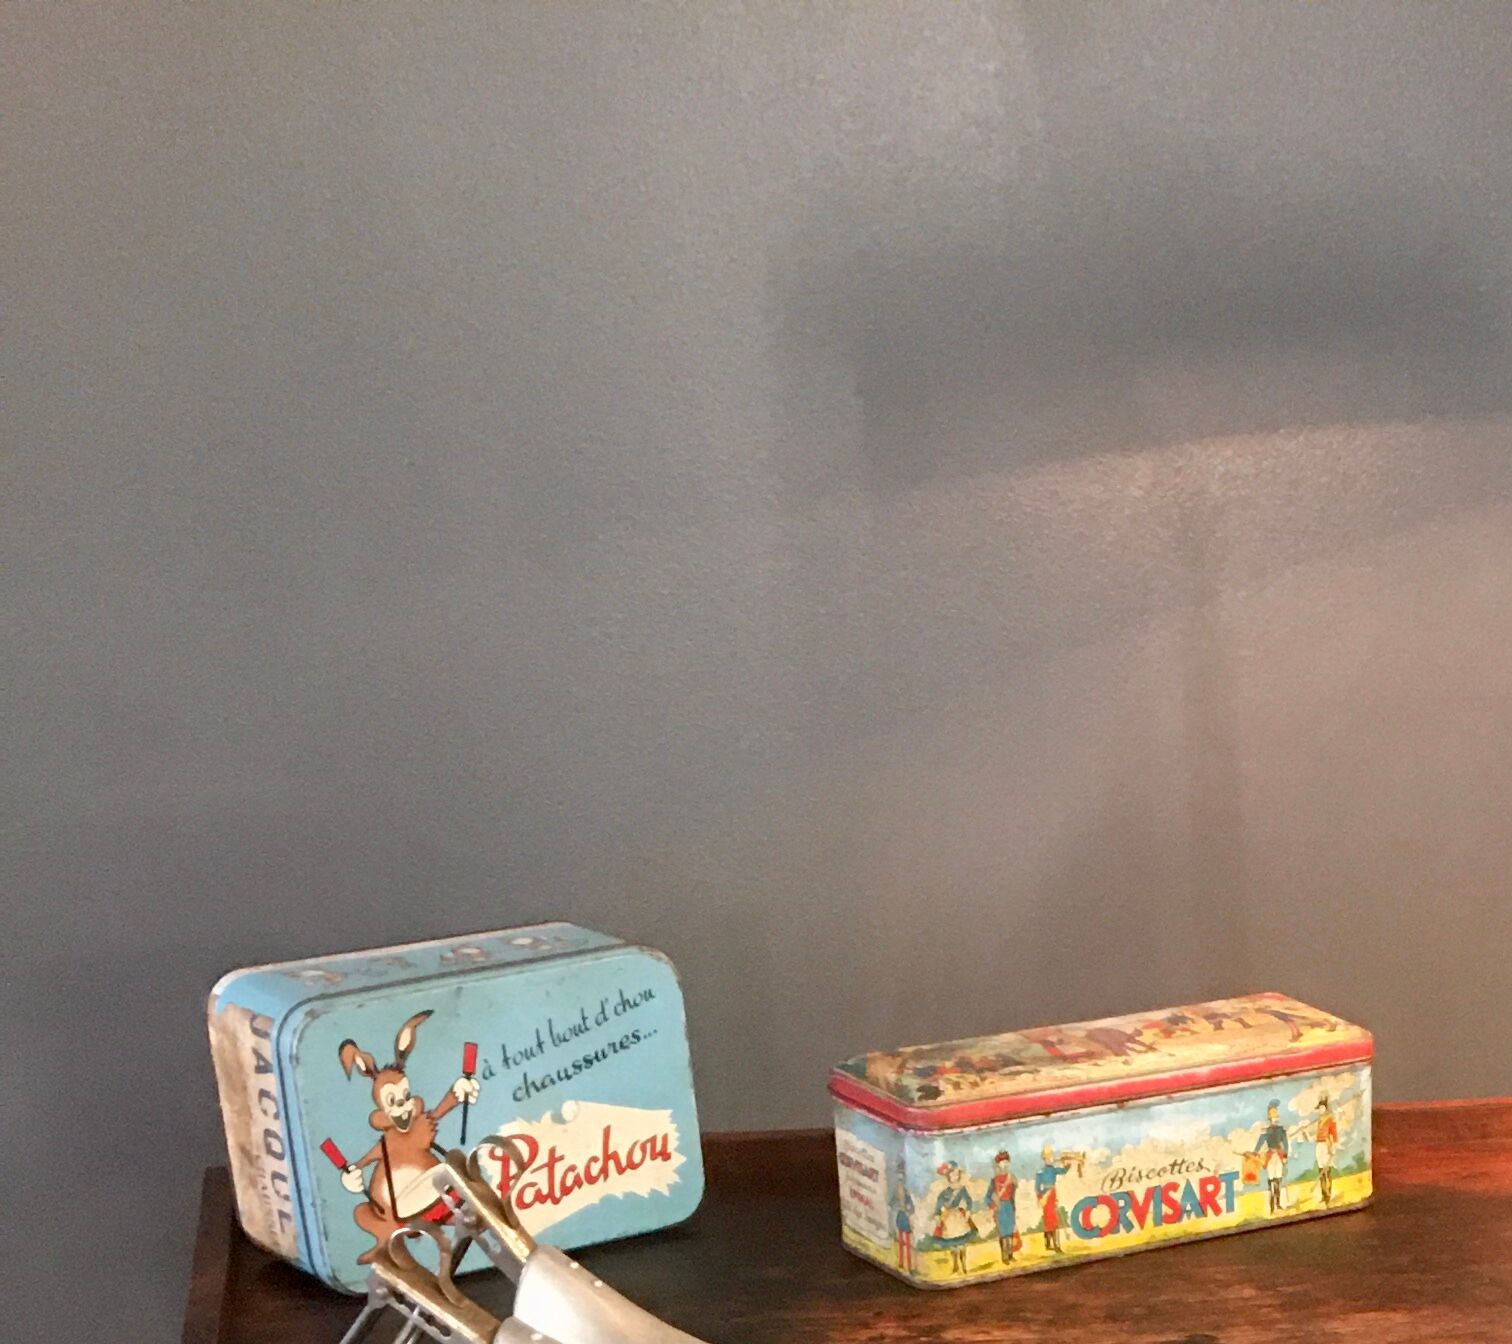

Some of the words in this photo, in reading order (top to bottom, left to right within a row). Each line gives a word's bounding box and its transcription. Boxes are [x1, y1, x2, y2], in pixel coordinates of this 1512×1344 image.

[482, 1058, 496, 1080] à
[501, 1028, 545, 1070] tout
[547, 1007, 590, 1047] bout
[488, 1124, 672, 1210] Patachou
[1101, 1157, 1211, 1193] Biscottes
[1070, 1170, 1240, 1240] CORVISART
